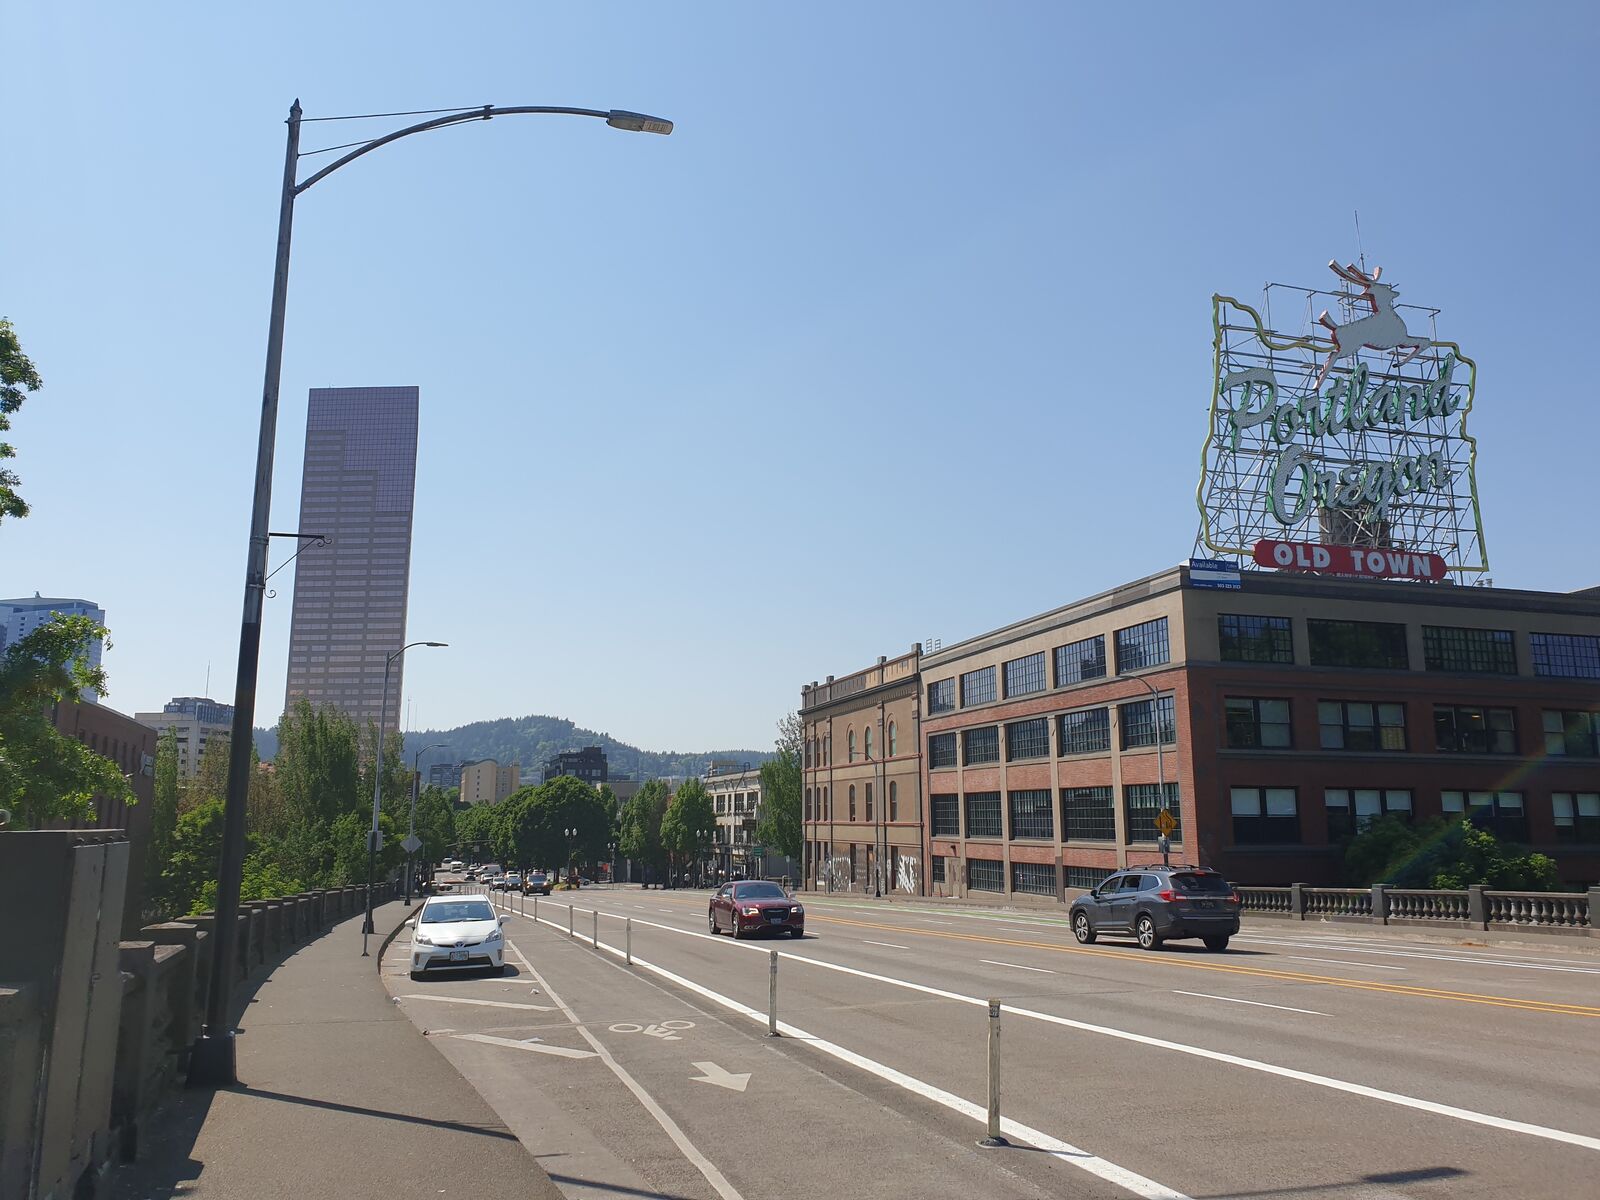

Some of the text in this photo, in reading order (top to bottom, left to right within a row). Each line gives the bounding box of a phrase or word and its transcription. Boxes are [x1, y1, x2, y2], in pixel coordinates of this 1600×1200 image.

[1221, 353, 1460, 452] Portland
[1267, 444, 1454, 525] Oregon
[1191, 560, 1218, 570] Available
[1273, 543, 1431, 577] OLD TOWN
